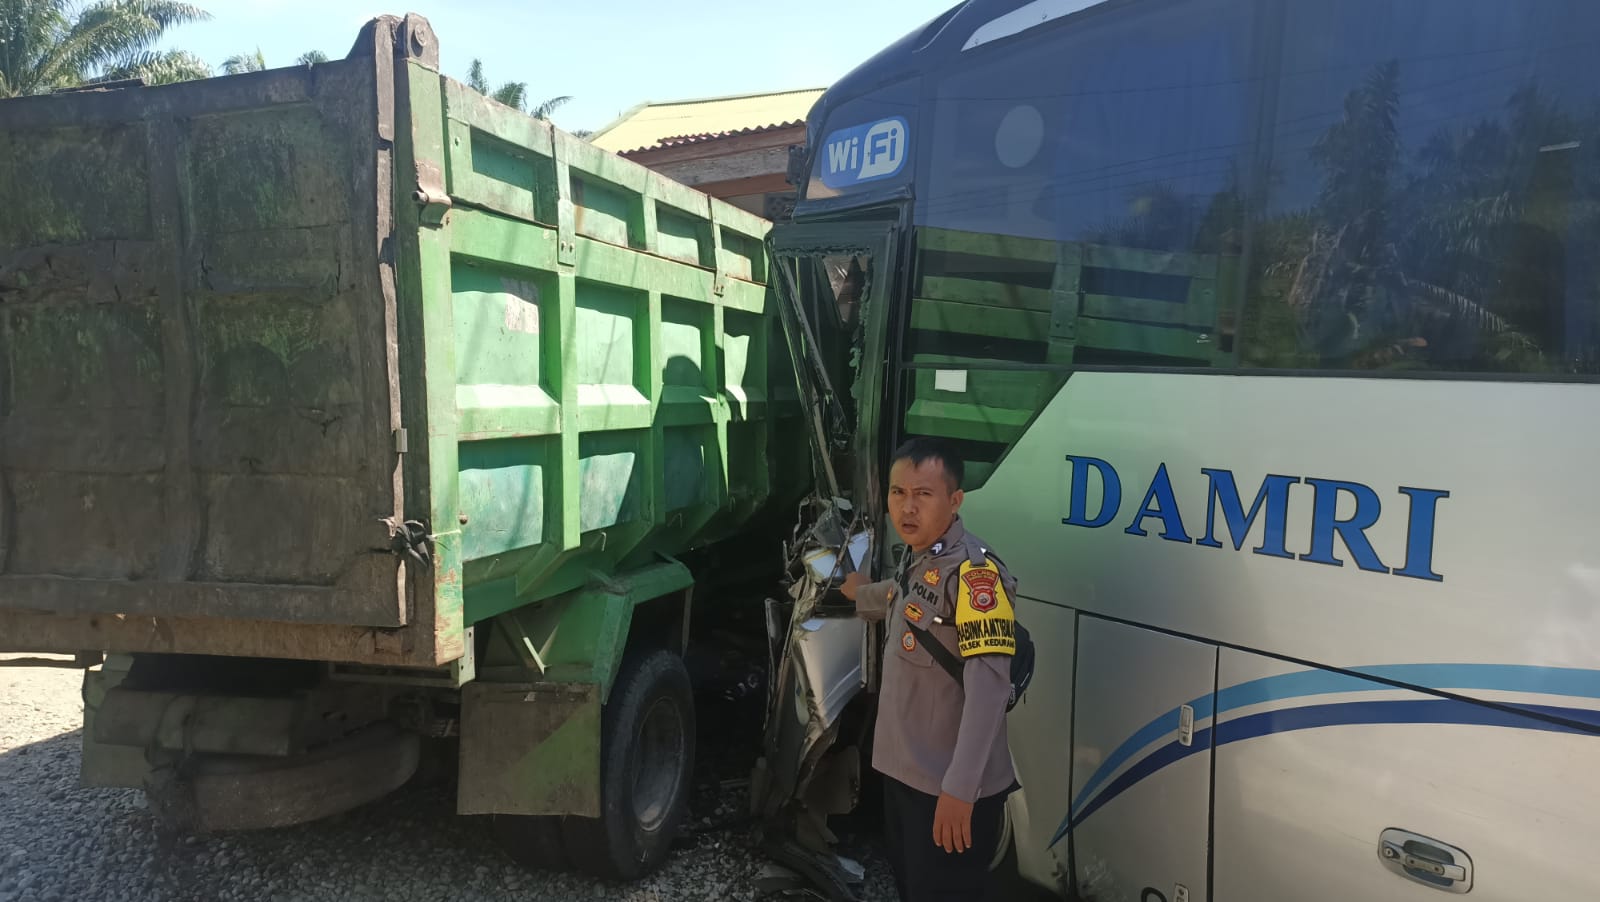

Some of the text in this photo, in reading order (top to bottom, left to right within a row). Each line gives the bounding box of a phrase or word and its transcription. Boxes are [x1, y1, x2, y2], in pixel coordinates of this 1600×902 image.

[1062, 454, 1450, 582] DAMRI
[911, 581, 939, 606] POLRI
[984, 638, 1015, 648] KEDURAN
